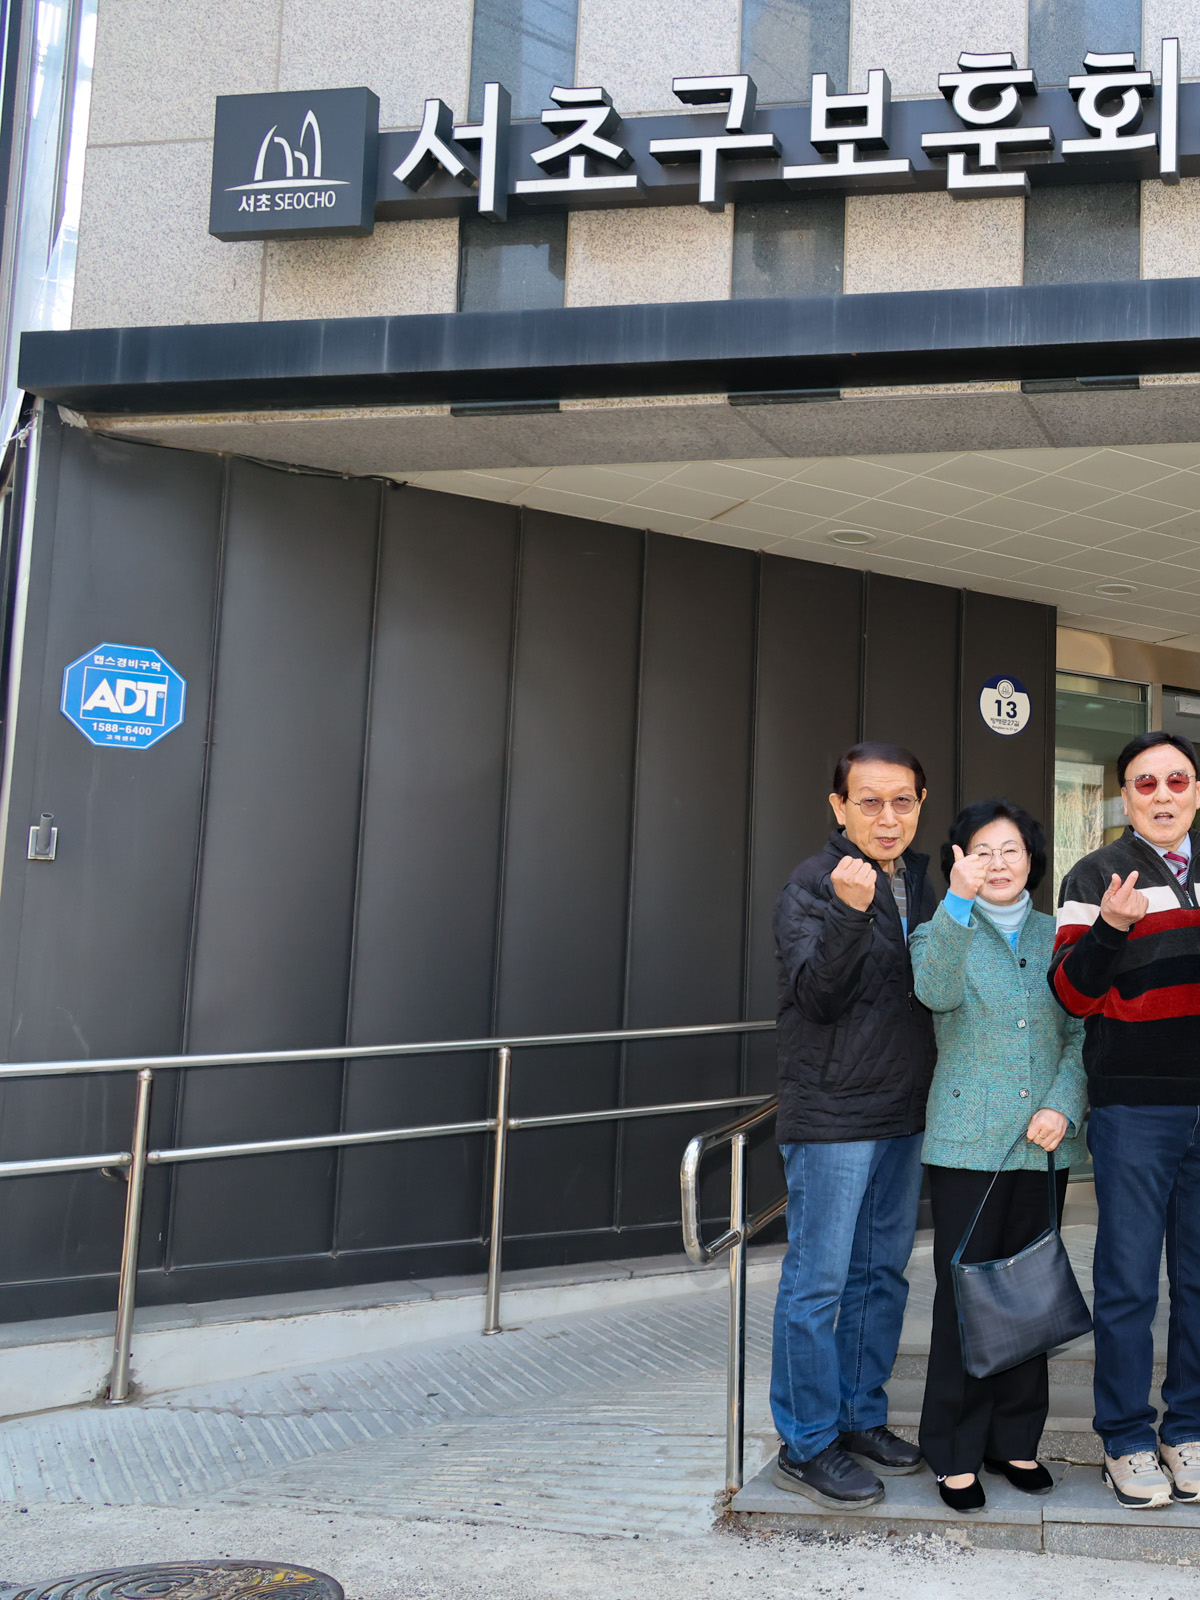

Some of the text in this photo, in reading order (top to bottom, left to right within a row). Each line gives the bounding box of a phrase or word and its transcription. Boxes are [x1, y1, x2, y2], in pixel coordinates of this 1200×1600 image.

[238, 190, 337, 213] 서초 SEOCHO
[994, 699, 1018, 719] 13
[92, 722, 153, 736] 1588-6400
